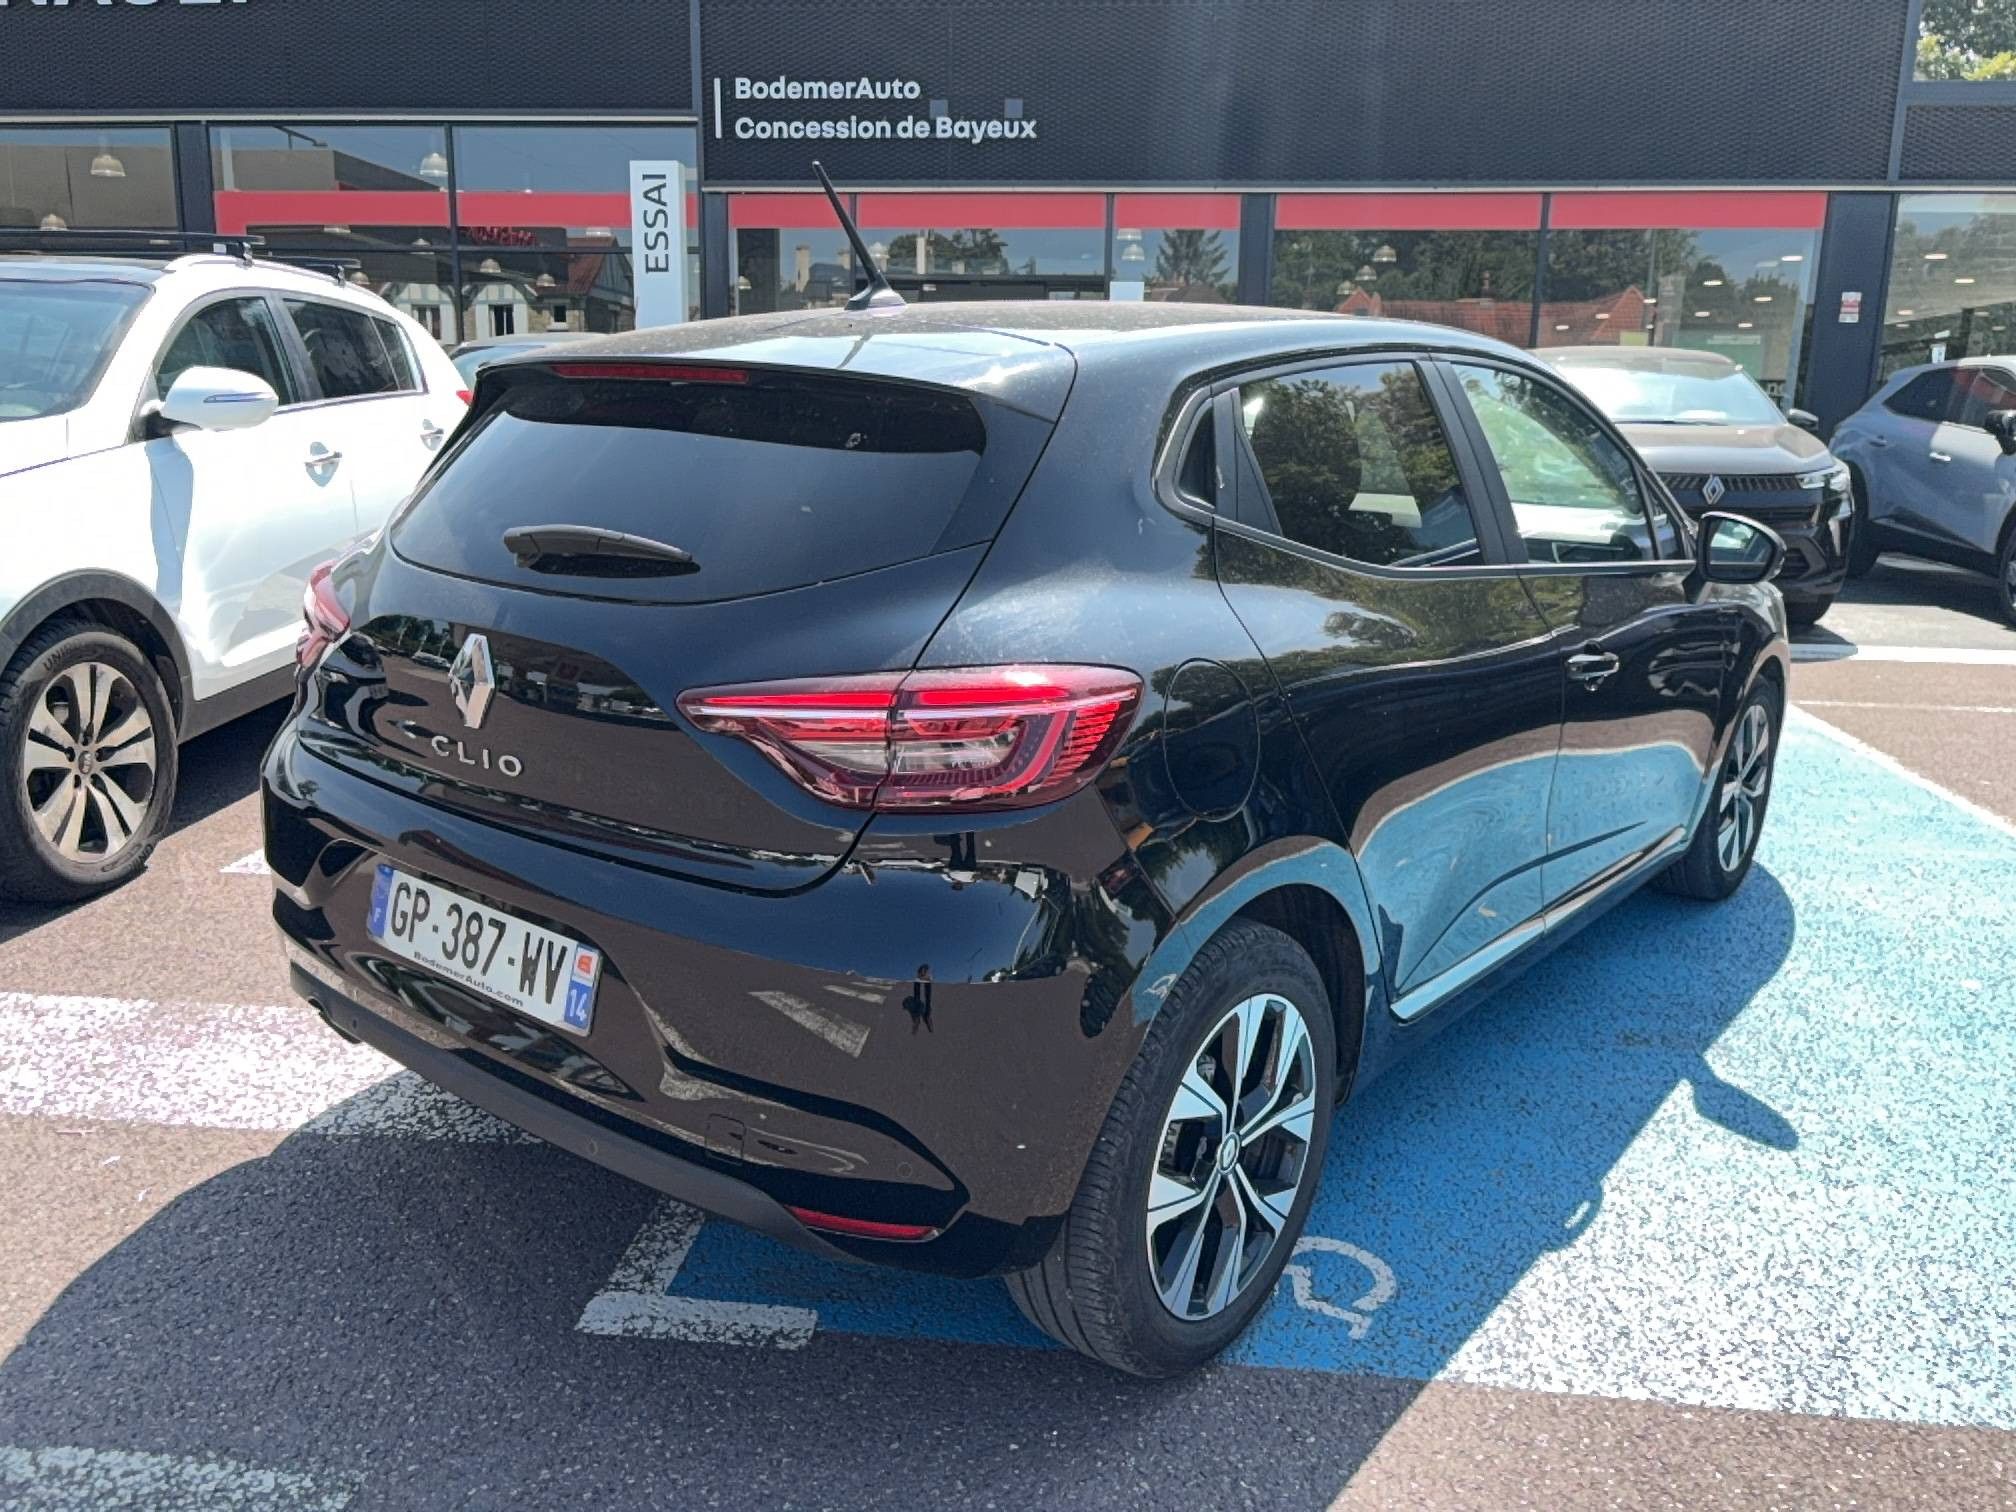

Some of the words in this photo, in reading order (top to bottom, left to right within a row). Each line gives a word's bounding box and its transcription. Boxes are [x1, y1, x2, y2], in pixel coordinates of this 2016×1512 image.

[734, 75, 921, 100] BodemerAuto
[734, 115, 892, 140] Concession
[896, 115, 931, 140] de
[935, 116, 1038, 145] Bayeux
[642, 173, 670, 275] ESSAI
[431, 735, 524, 778] CLIO
[390, 882, 568, 1005] GP-387-WV
[413, 951, 525, 1008] BodemerAuto.com
[566, 989, 588, 1022] 14
